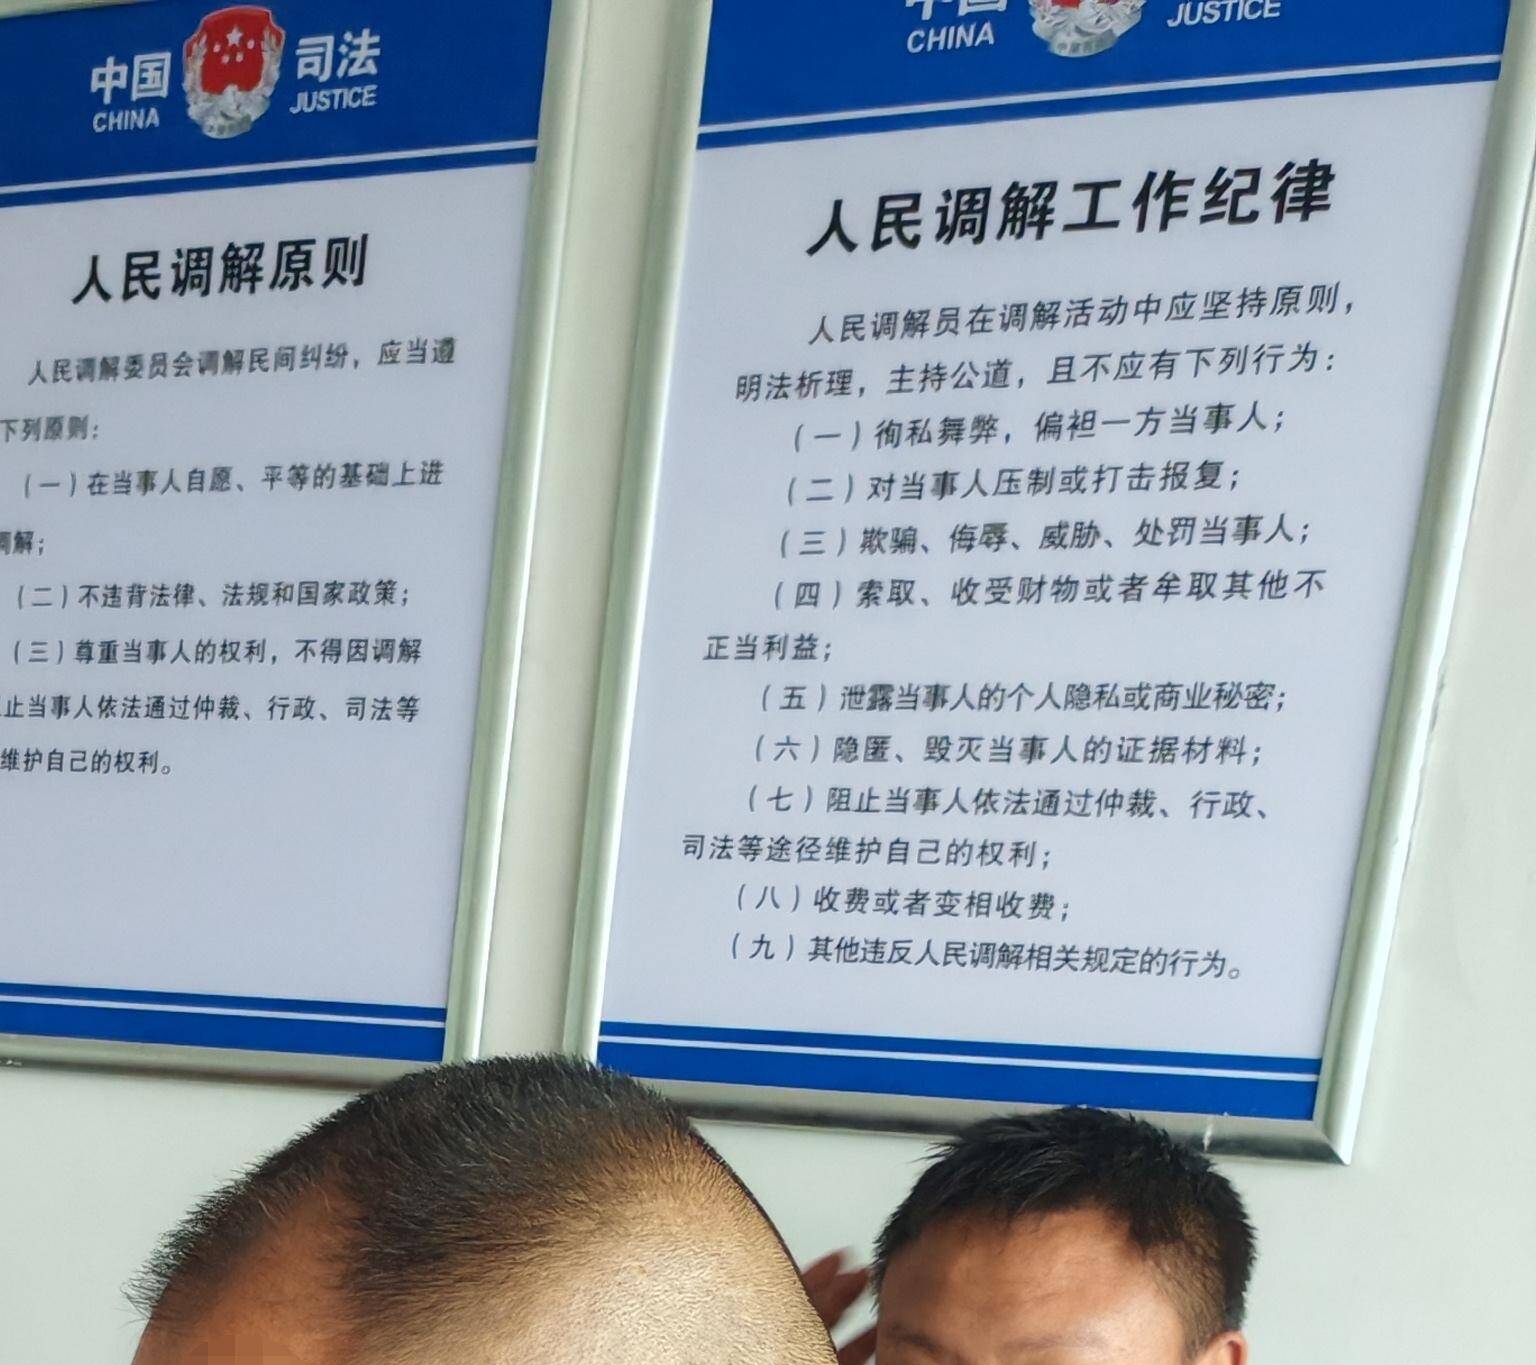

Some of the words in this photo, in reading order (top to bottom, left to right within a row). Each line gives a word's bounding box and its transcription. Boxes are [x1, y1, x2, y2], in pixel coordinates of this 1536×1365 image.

[906, 20, 994, 53] CHINA
[1167, 0, 1282, 28] JUSTICE
[91, 52, 172, 104] 中国
[296, 29, 381, 83] 司法
[93, 108, 159, 133] CHINA
[290, 85, 378, 114] JUSTICE
[806, 157, 1335, 258] 人民调解工作纪律
[72, 232, 370, 304] 人民调解原则
[808, 281, 1356, 347] 人民调解员在调解活动中应坚持原则，
[735, 343, 1337, 404] 明法析理，主持公道，且不应有下列行为：
[794, 403, 1289, 454] （一）徇私舞弊，偏袒一方当事人；
[23, 460, 445, 498] （一）在当事人自愿、平等的基础上进
[787, 460, 1242, 507] （二）对当事人压制或打击报复；
[780, 512, 1314, 559] （三）欺骗、侮辱、威胁、处罚当事人；
[16, 580, 409, 611] （二）不违背法律、法规和国家政策；
[774, 569, 1329, 610] （四）索取、收受财物或者牟取其他不
[13, 639, 423, 668] （三）尊重当事人的权利，不得因调解
[703, 635, 835, 662] 正当利益；
[761, 682, 1287, 714] （五）泄露当事人的个人隐私或商业秘密；
[754, 733, 1263, 769] （六）隐匿、毁灭当事人的证据材料；
[748, 785, 1271, 822] （七）阻止当事人依法通过仲裁、行政、
[682, 835, 1053, 872] 司法等途径维护自己的权利；
[737, 883, 1070, 922] （八）收费或者变相收费；
[730, 931, 1244, 981] （九）其他违反人民调解相关规定的行为。
